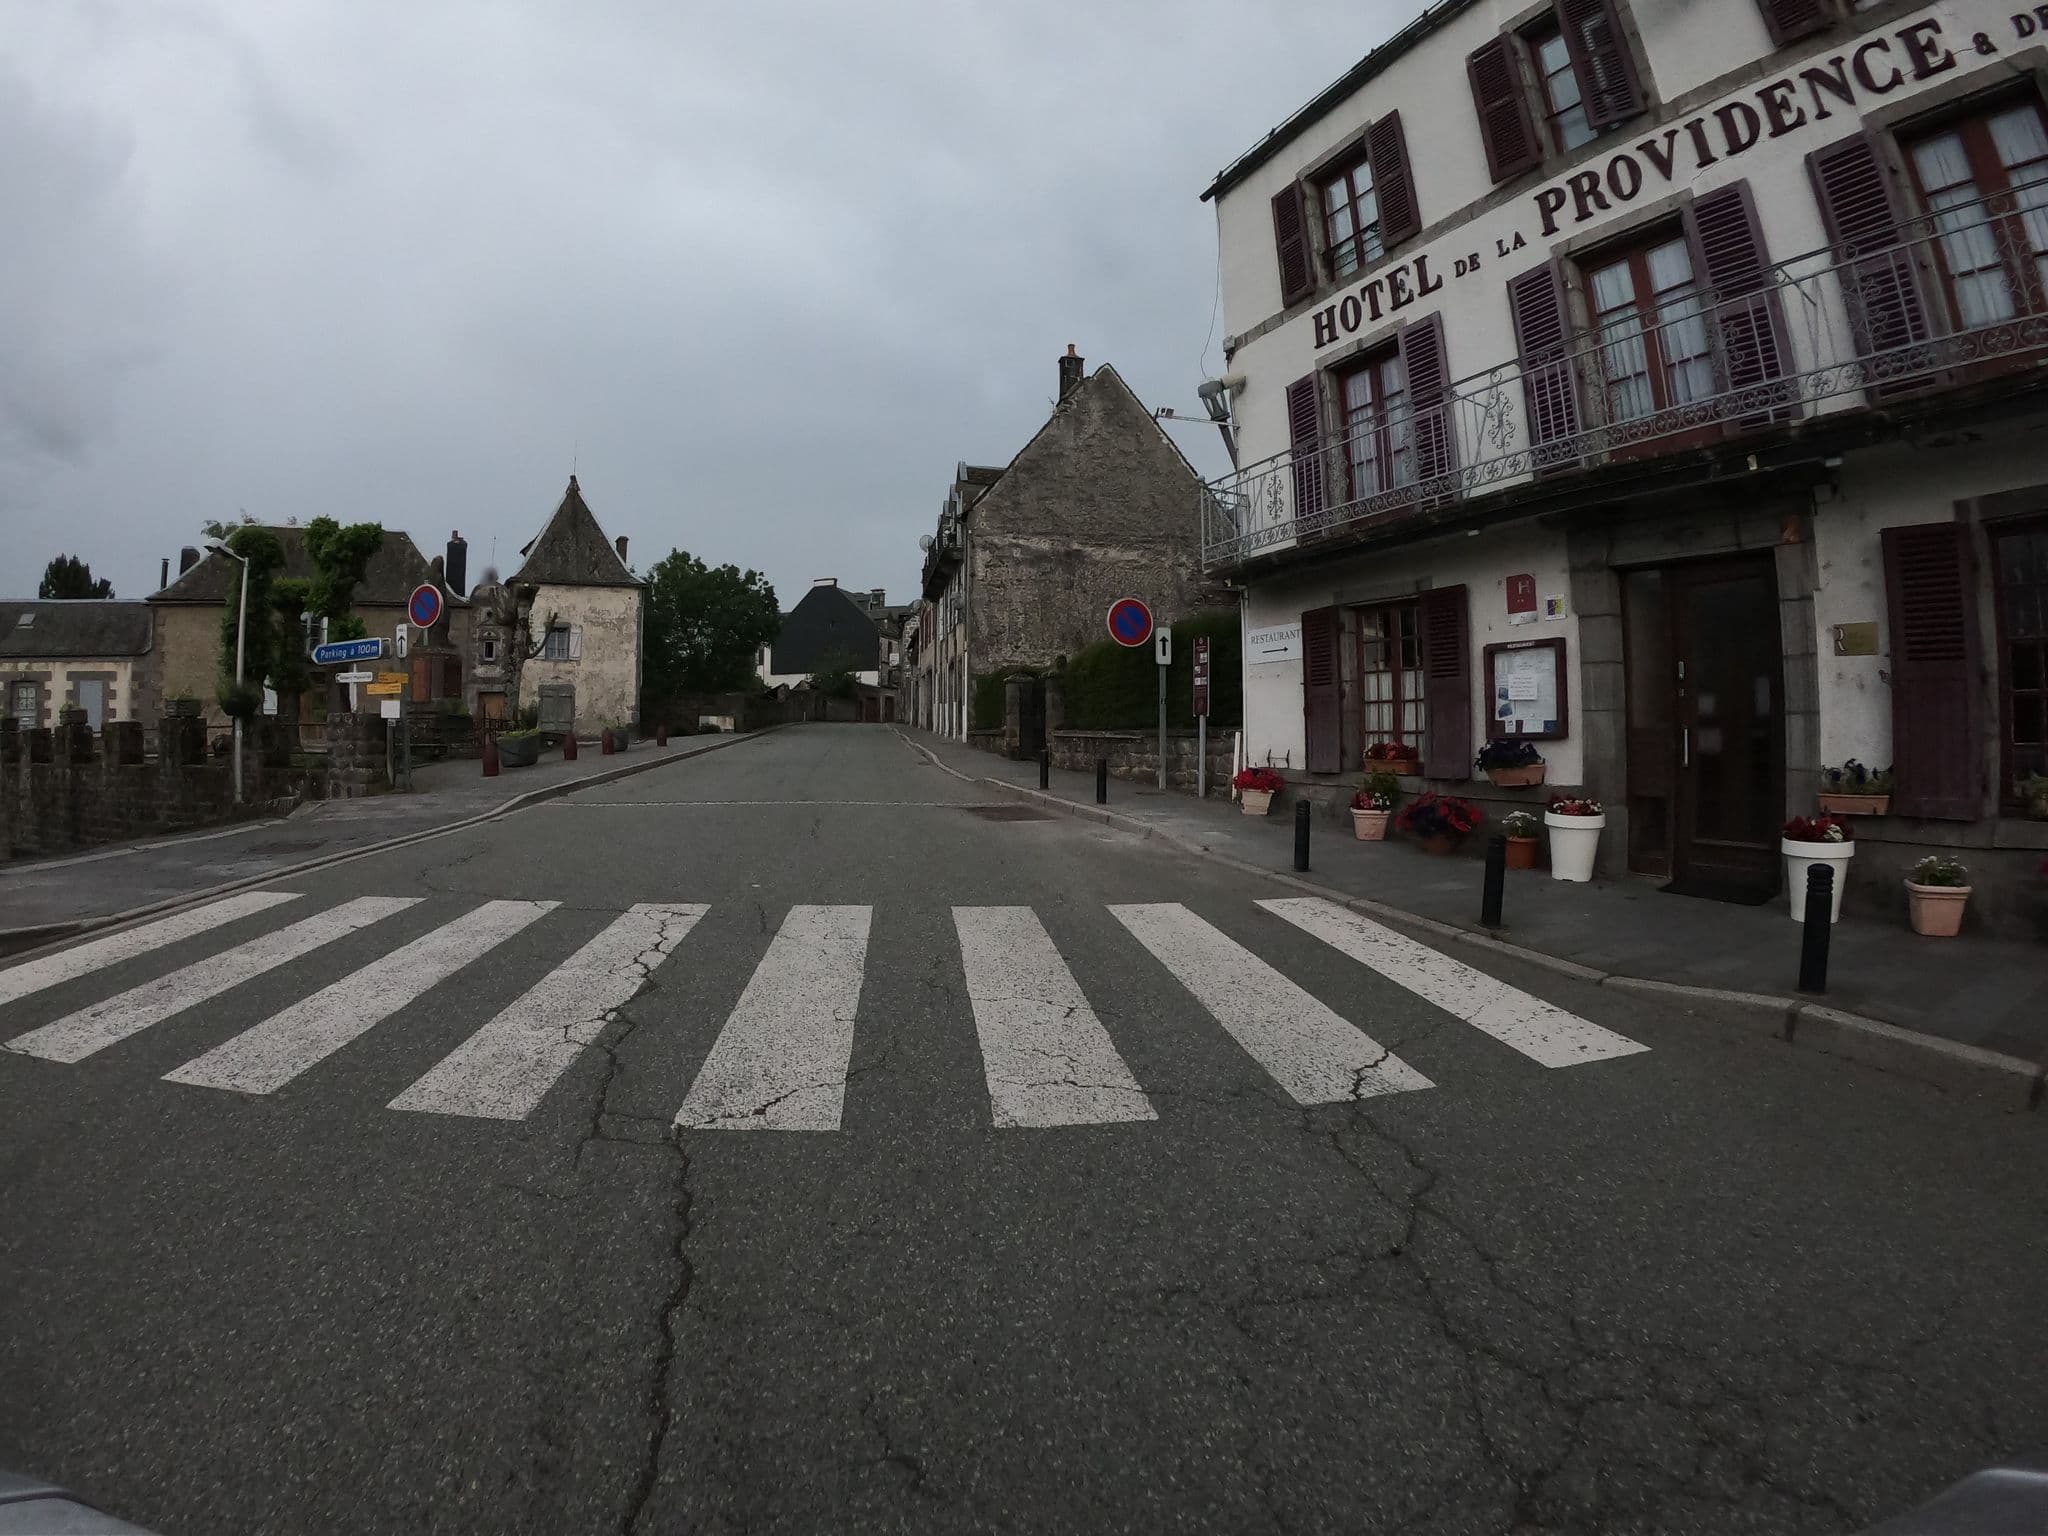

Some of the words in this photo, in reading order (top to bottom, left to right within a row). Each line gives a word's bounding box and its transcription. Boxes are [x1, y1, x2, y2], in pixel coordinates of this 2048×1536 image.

[1312, 255, 1443, 349] HOTEL
[1454, 252, 1481, 278] DE
[1496, 231, 1527, 257] LA
[1533, 17, 1957, 237] PROVIDENCE
[1972, 32, 1998, 55] &
[1518, 580, 1530, 595] H
[1250, 629, 1300, 645] RESTAURANT
[320, 648, 347, 659] Parking
